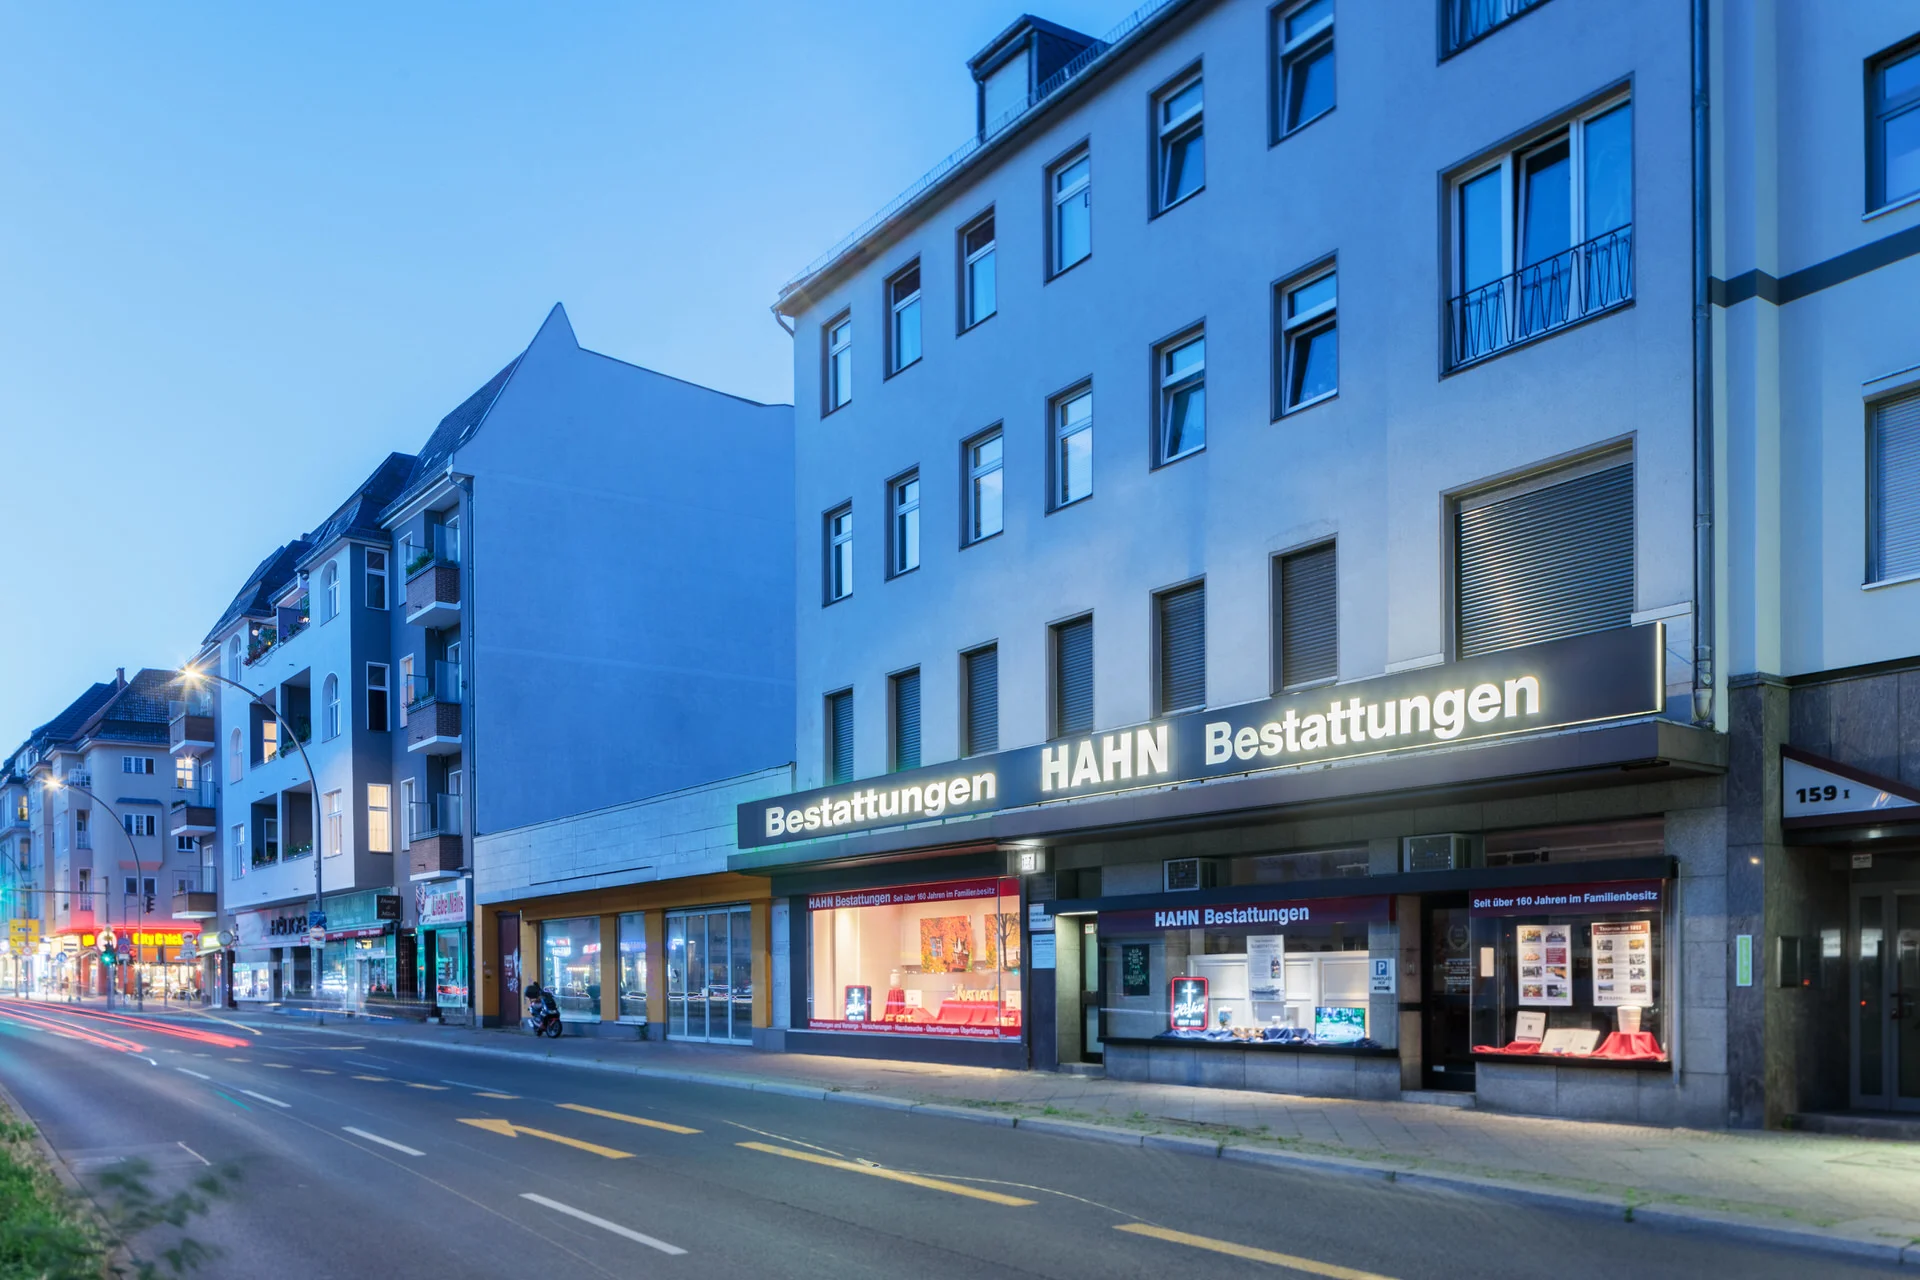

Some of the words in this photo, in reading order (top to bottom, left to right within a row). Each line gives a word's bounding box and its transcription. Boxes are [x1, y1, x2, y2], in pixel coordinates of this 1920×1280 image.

[766, 772, 996, 838] Bestattungen
[1041, 724, 1169, 792] HAHN
[1204, 674, 1540, 767] Bestattungen
[1796, 785, 1837, 803] 159
[809, 896, 834, 909] HAHN
[835, 893, 891, 906] Bestattungen
[893, 894, 903, 902] Seit
[904, 893, 916, 901] über
[927, 891, 945, 900] Jahren
[946, 890, 953, 898] im
[1473, 898, 1491, 908] Seit
[1493, 897, 1513, 907] über
[1516, 896, 1532, 906] 160
[1534, 895, 1567, 905] Jahren
[1569, 894, 1581, 903] im
[1583, 890, 1658, 903] Familienbesitz
[1155, 909, 1199, 927] HAHN
[1204, 906, 1310, 926] Bestattungen
